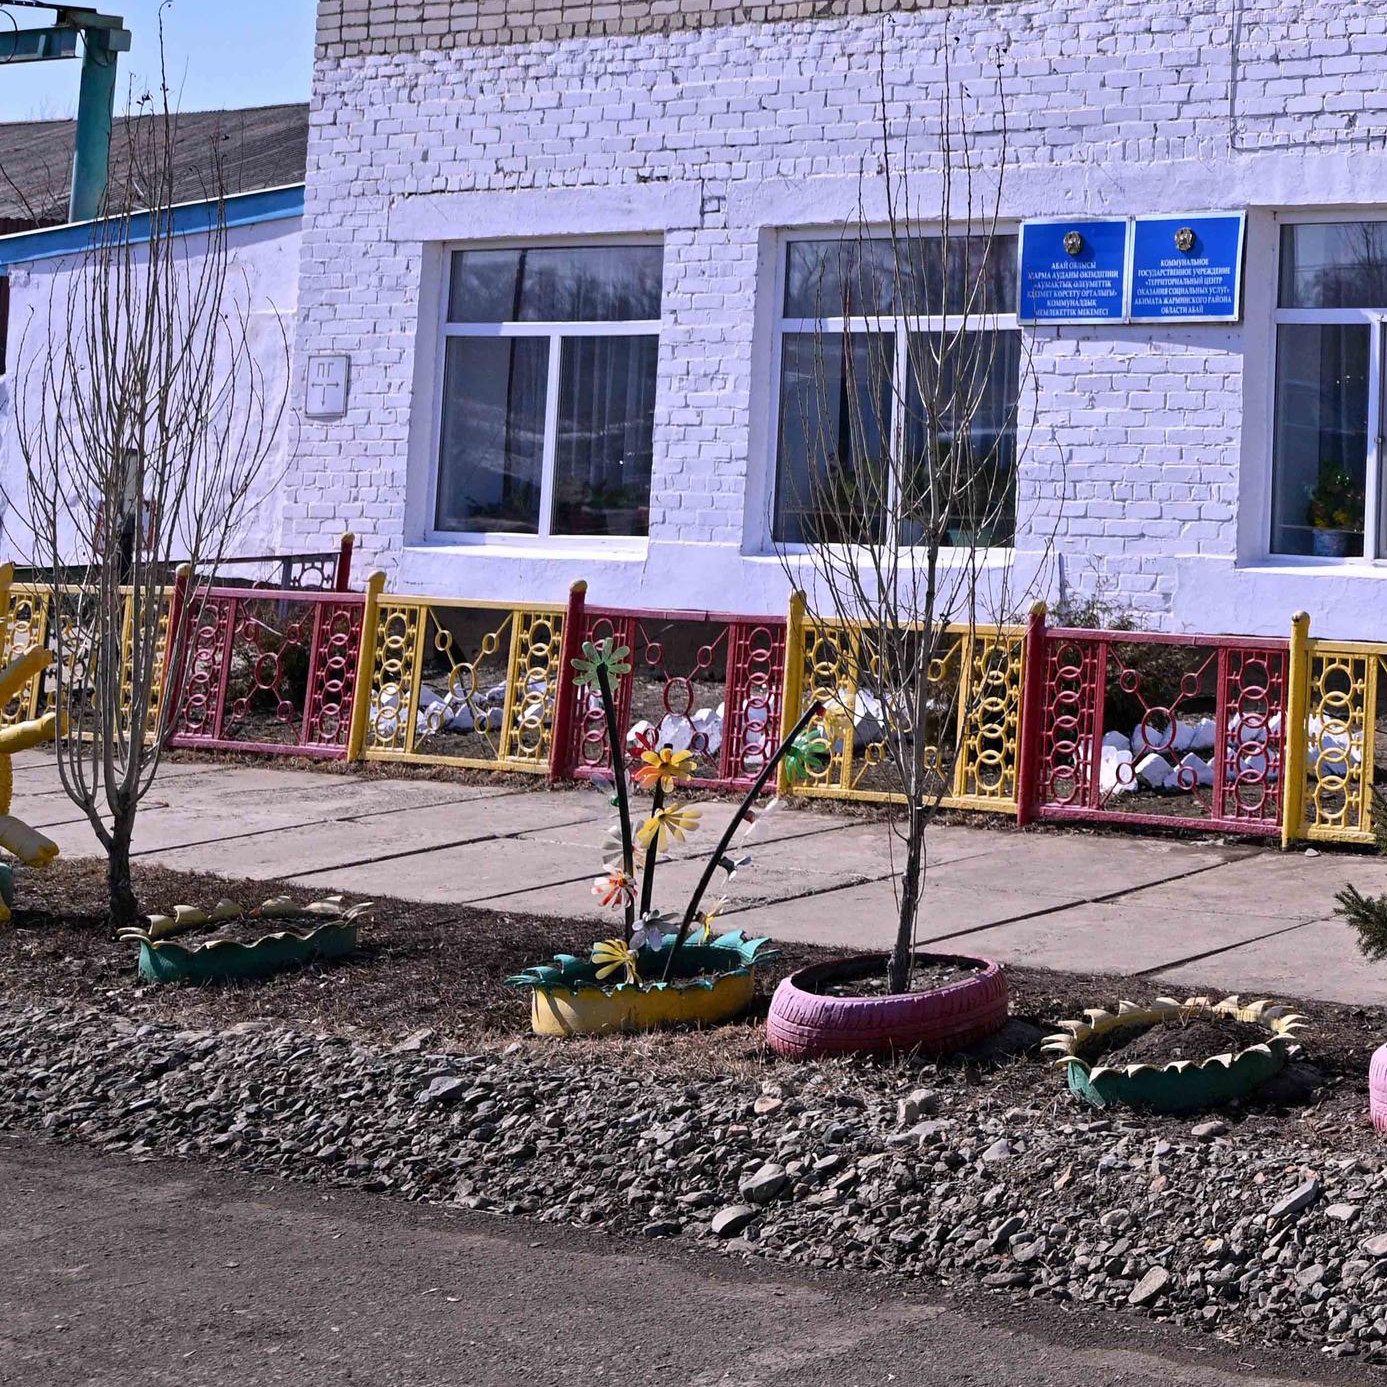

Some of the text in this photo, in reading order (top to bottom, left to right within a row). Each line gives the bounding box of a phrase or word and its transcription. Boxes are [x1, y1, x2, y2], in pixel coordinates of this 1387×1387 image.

[1161, 258, 1209, 266] КОММУНАЛЬНОЕ
[1052, 271, 1079, 280] АУДАНЫ
[1138, 267, 1231, 277] ГОСУДАРСТВЕННОЕ УЧРЕЖДЕНИЕ
[1204, 276, 1223, 285] ЦЕНТР
[1137, 288, 1168, 296] ОКАЗАНИЯ
[1169, 287, 1208, 296] СОЦИАЛЬНЫХ
[1077, 308, 1109, 316] МЕКЕМЕСІ
[1161, 305, 1204, 314] ОБЛАСТИ АБАЙ
[317, 362, 334, 378] ПГ
